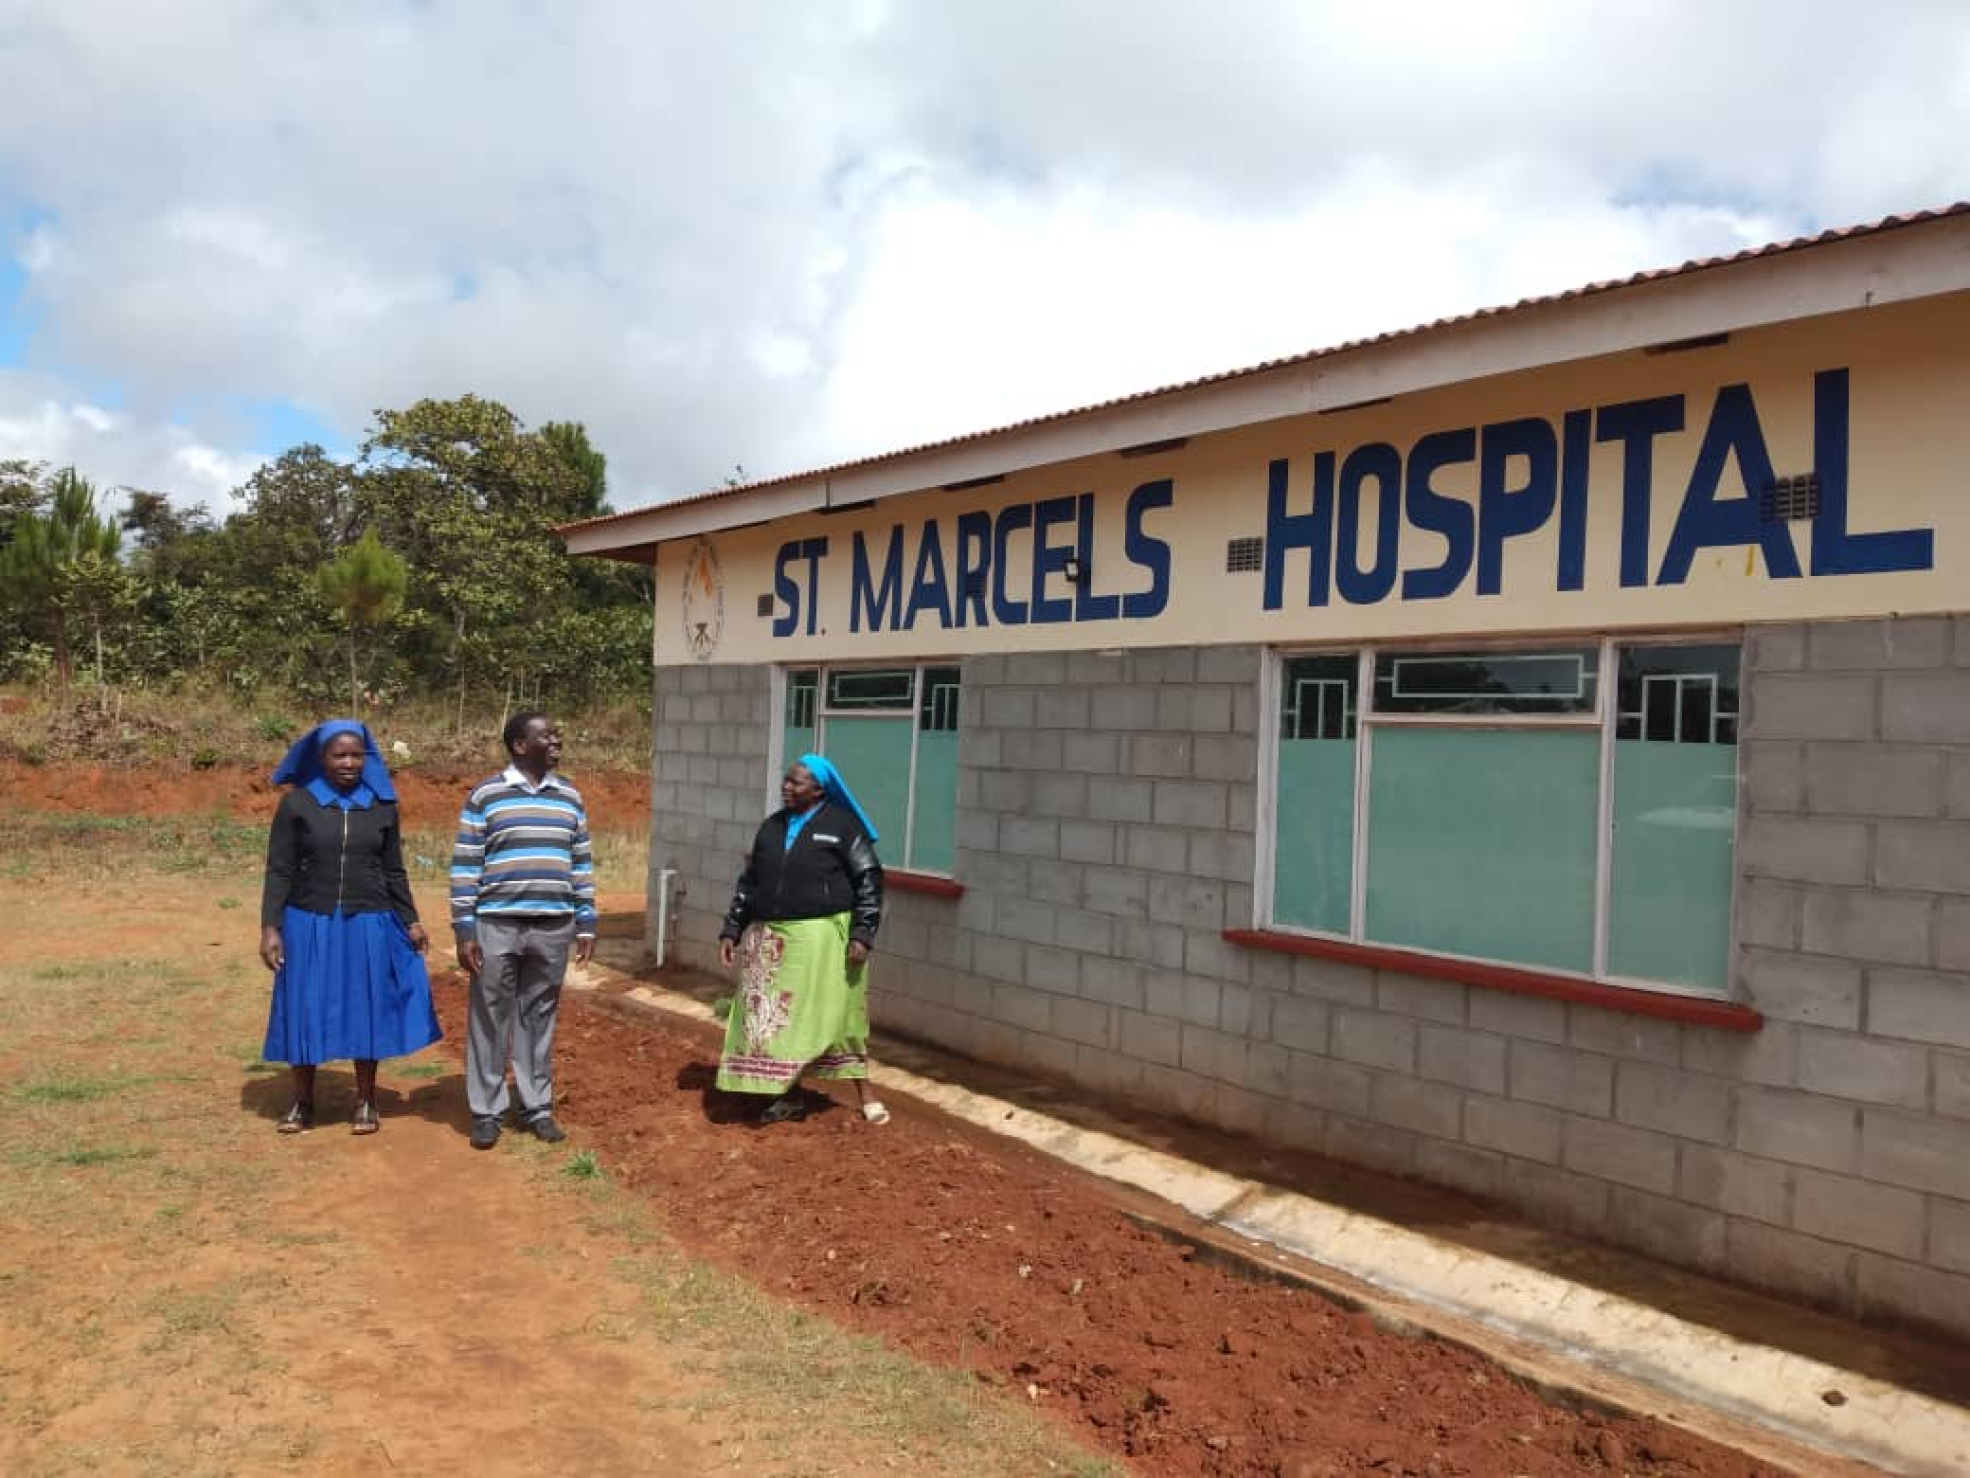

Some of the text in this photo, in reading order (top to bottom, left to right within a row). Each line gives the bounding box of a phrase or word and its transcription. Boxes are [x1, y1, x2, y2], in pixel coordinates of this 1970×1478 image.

[773, 536, 828, 637] ST.
[849, 479, 1174, 634] MARCELS
[1263, 367, 1934, 610] HOSPITAL
